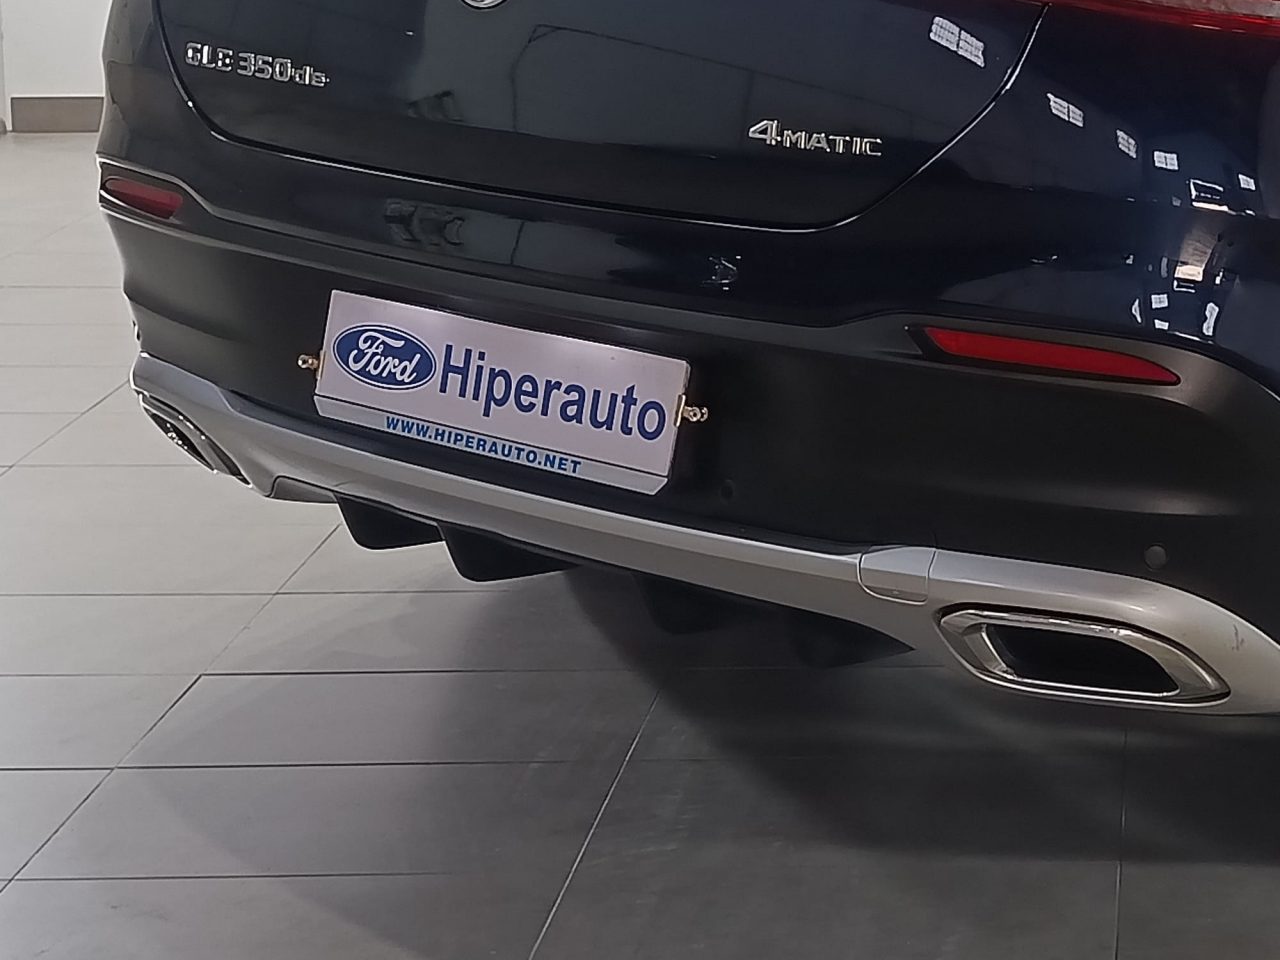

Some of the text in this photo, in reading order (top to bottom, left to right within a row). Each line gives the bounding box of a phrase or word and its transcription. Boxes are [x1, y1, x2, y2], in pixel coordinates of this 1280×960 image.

[185, 42, 234, 72] GLE
[749, 119, 882, 156] 4MATIC
[348, 331, 667, 441] Ford Hiperauto
[385, 415, 582, 475] WWW.HIPERAUTO.NET
